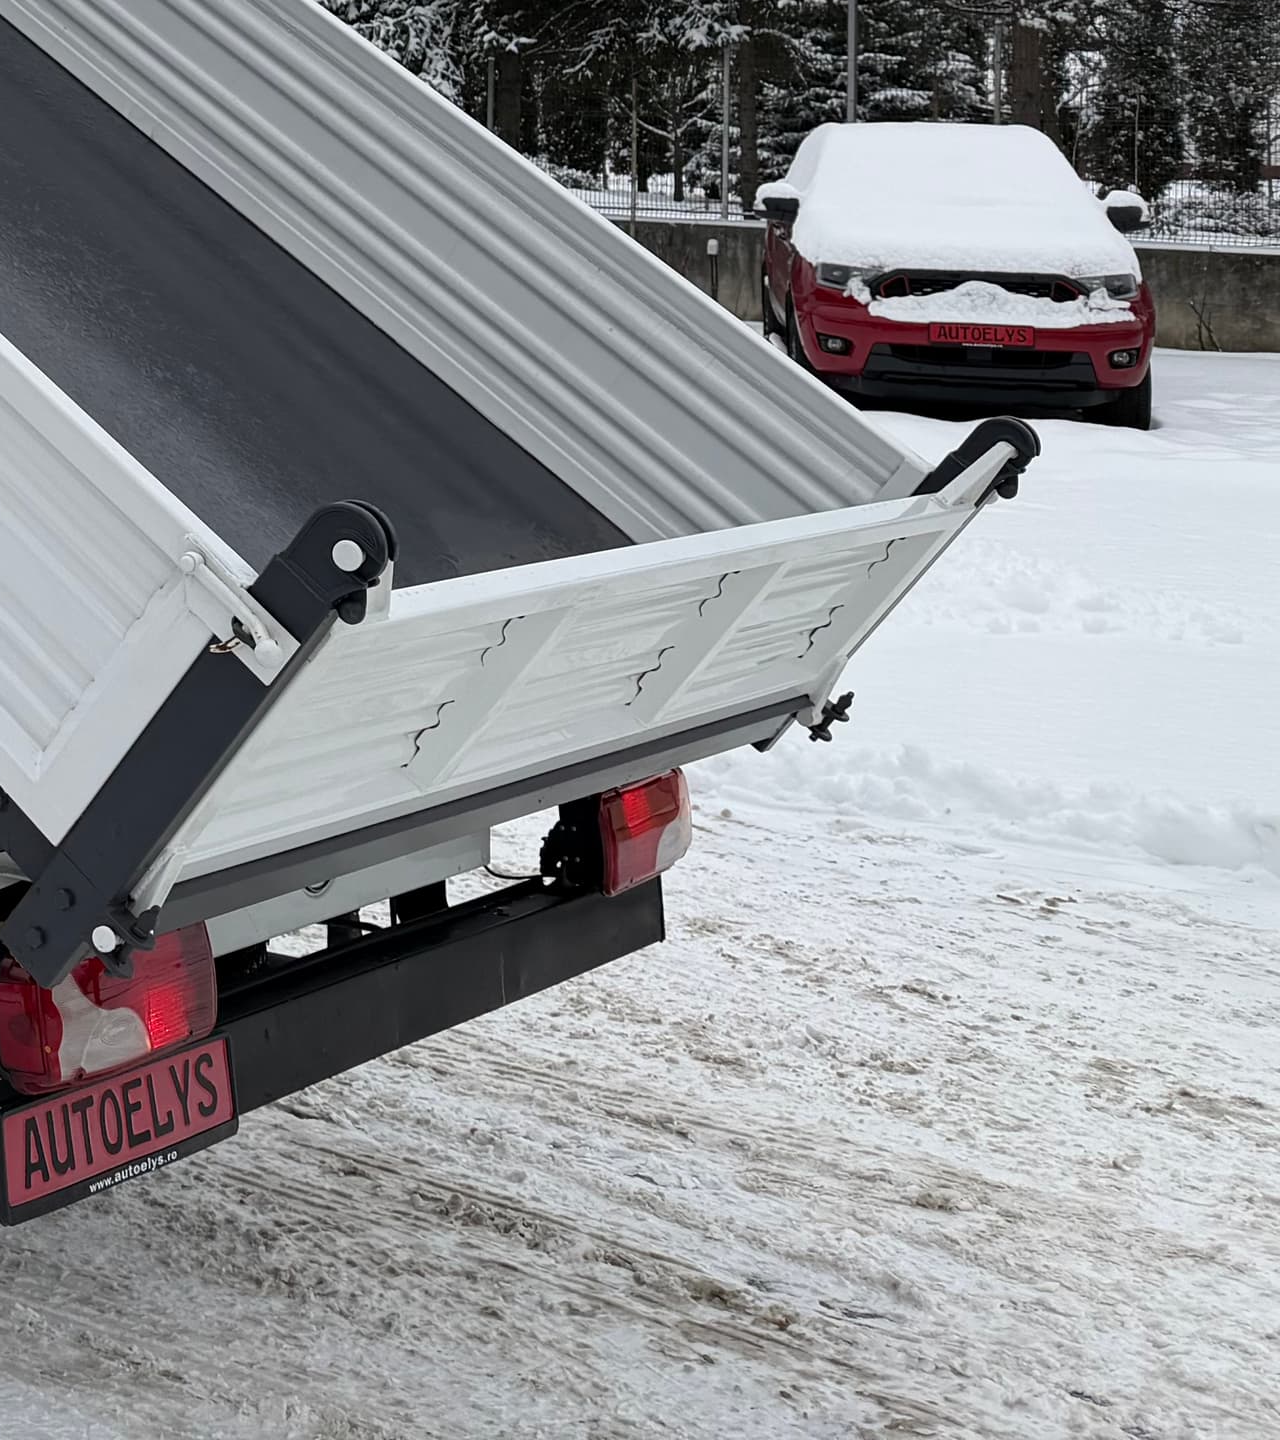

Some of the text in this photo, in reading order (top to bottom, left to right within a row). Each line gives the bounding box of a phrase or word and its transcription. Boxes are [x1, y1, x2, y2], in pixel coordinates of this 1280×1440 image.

[937, 325, 1027, 343] AUTOELYS
[25, 1053, 217, 1189] AUTOELYS
[89, 1151, 178, 1193] www.autoelys.ro
